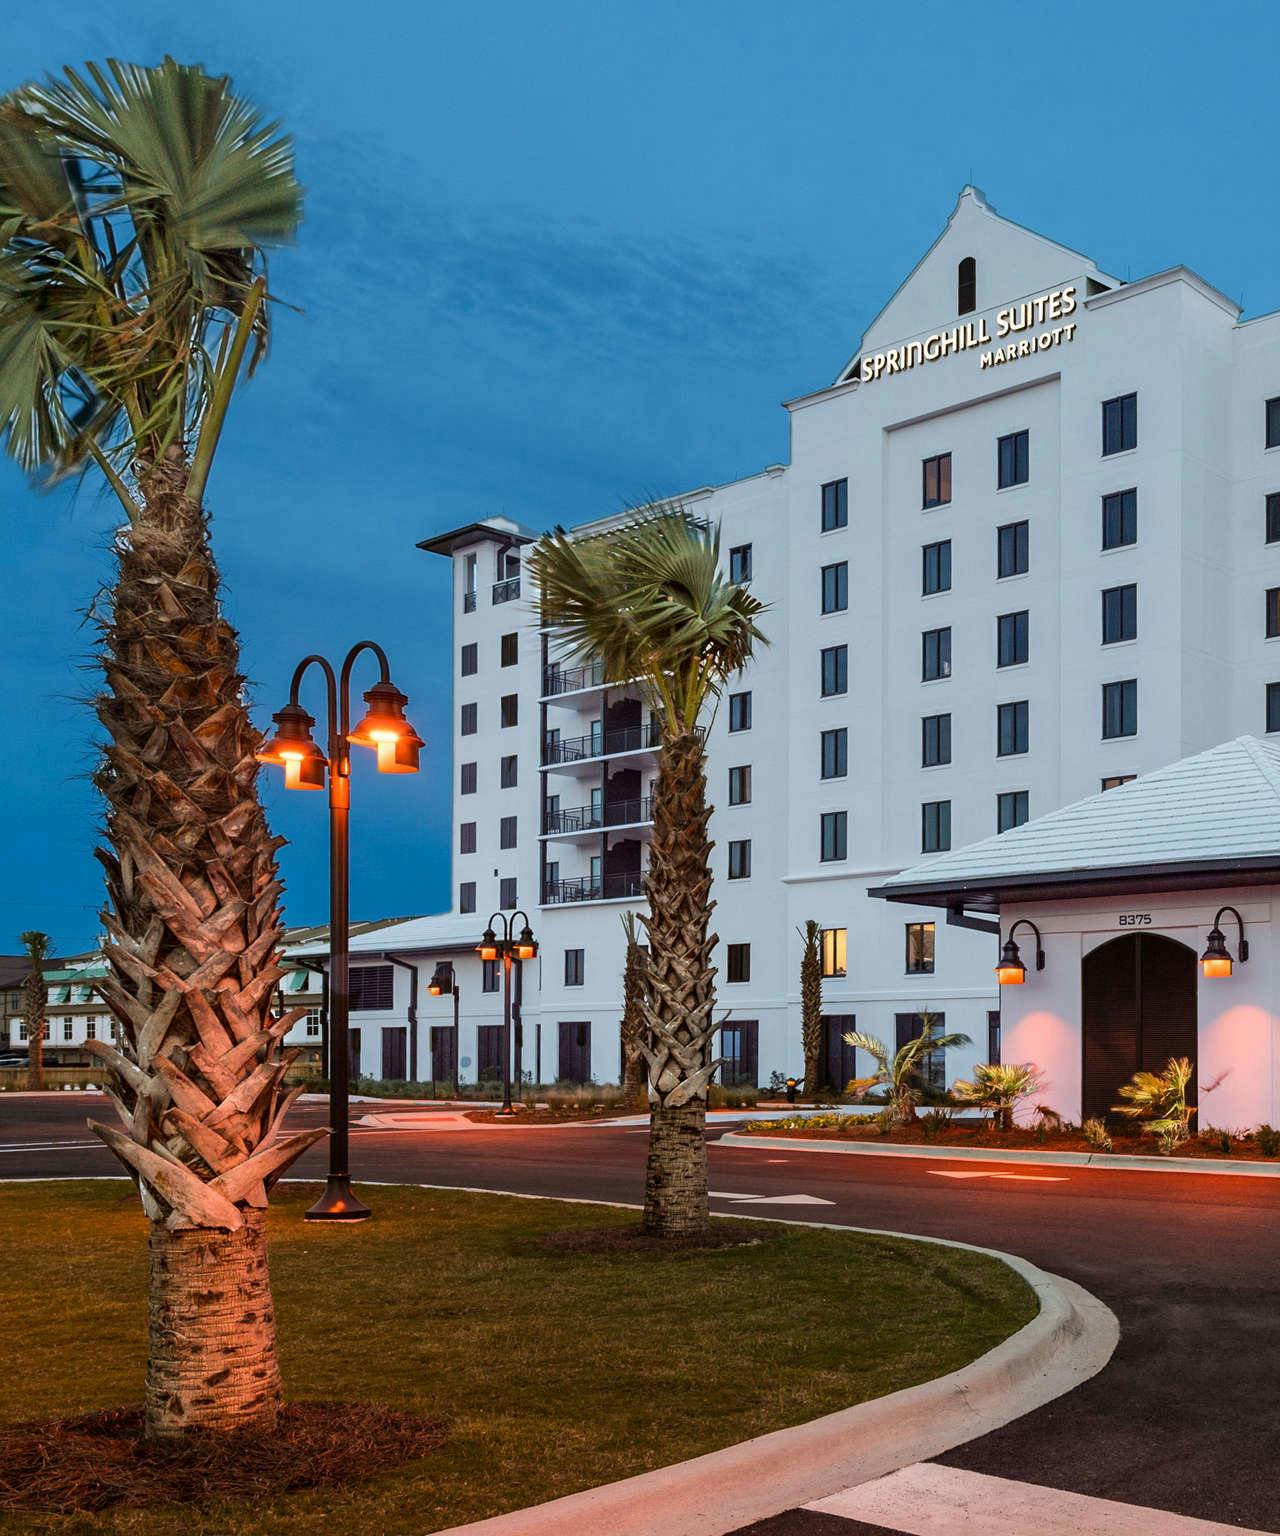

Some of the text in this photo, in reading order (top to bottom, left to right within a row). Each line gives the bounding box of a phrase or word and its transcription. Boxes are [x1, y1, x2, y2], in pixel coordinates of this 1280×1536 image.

[996, 286, 1077, 337] SUITES
[980, 323, 1077, 369] MARRIOTT
[1119, 914, 1152, 926] 8375
